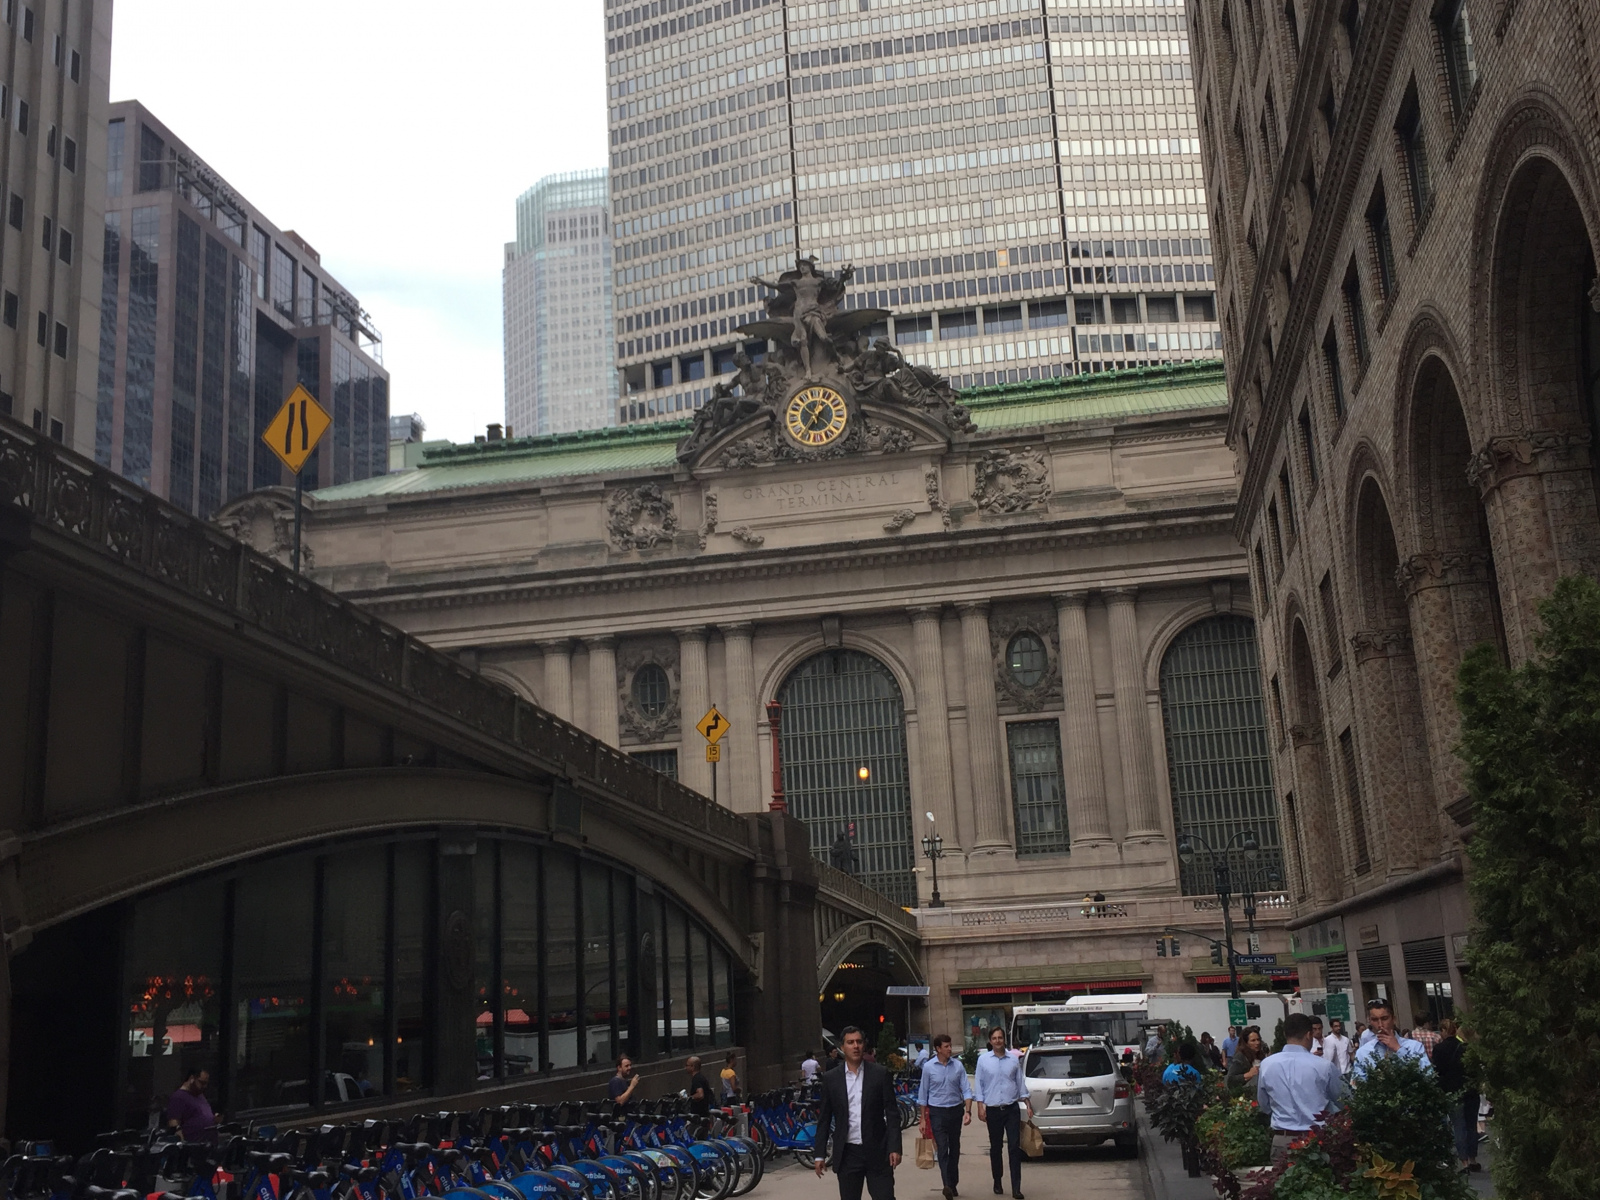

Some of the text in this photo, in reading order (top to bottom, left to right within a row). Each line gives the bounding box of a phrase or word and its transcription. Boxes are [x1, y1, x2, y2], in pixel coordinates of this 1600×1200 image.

[743, 473, 899, 500] GRAND CENTRAL
[776, 491, 865, 509] TERMINAL
[709, 747, 717, 755] 15
[1252, 944, 1259, 952] 25
